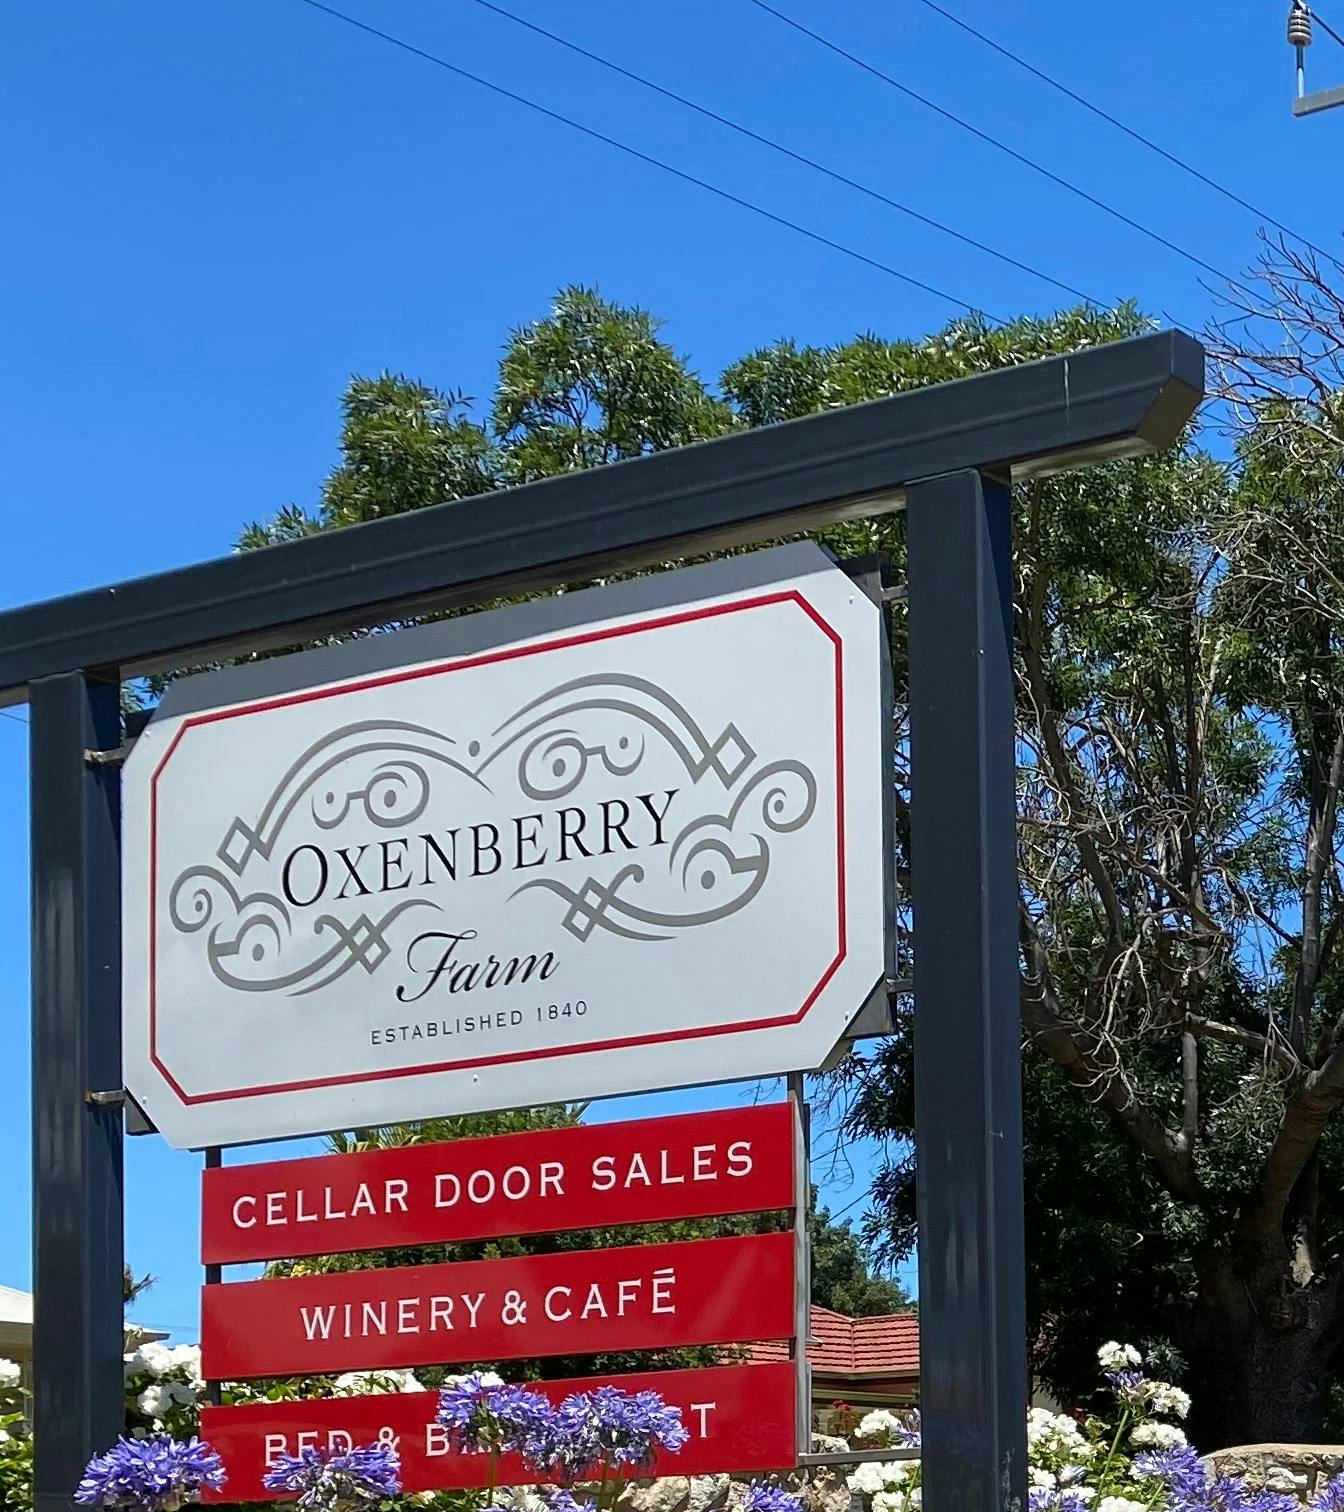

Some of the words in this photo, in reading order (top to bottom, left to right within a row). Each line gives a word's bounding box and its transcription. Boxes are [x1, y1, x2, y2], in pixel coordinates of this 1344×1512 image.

[281, 788, 681, 908] OXENBERRY
[395, 929, 560, 1004] Farm
[371, 1010, 524, 1045] ESTABLISHED
[535, 1000, 588, 1022] 1840
[232, 1179, 409, 1229] CELLAR
[434, 1161, 565, 1209] DOOR
[591, 1141, 754, 1192] SALES
[300, 1292, 486, 1341] WINERY
[501, 1290, 527, 1325] &
[544, 1268, 677, 1322] CAFÉ
